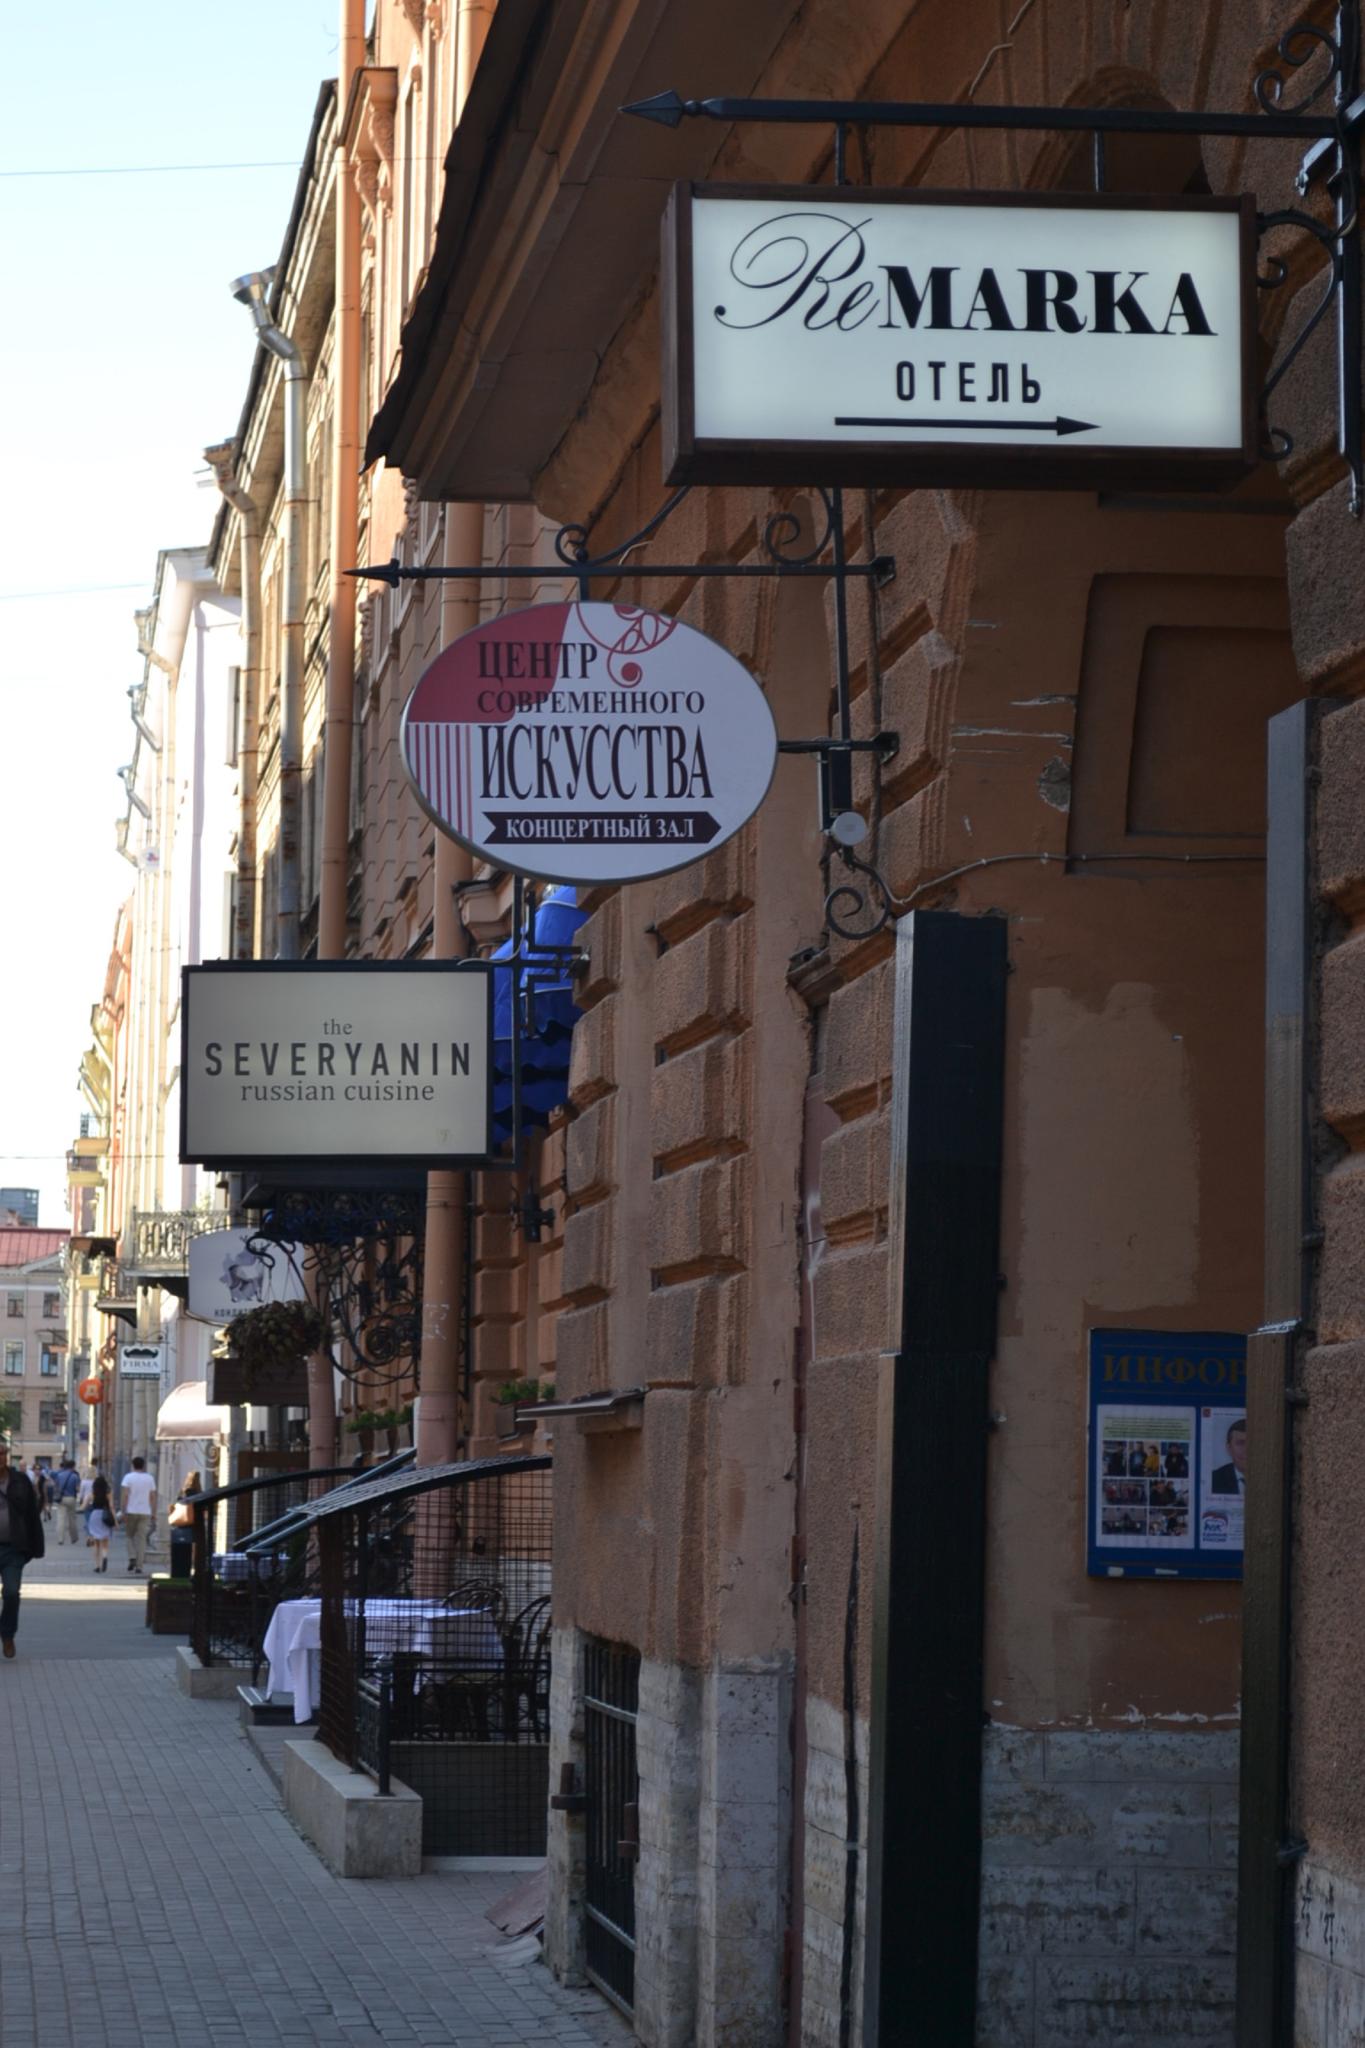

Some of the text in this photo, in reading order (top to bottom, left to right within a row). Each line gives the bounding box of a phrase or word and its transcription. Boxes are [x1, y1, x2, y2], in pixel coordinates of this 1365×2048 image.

[895, 360, 1041, 404] ОТЕЛЬ
[477, 641, 598, 684] ЦЕНТР
[476, 690, 705, 714] СОВРЕМЕННОГО
[477, 723, 715, 800] ИСКУССТВА
[505, 814, 695, 841] КОНЦЕРТНЫЙ ЗАЛ
[323, 1019, 353, 1035] the
[204, 1042, 470, 1077] SEVERYANIN
[240, 1080, 435, 1102] russian cuisine
